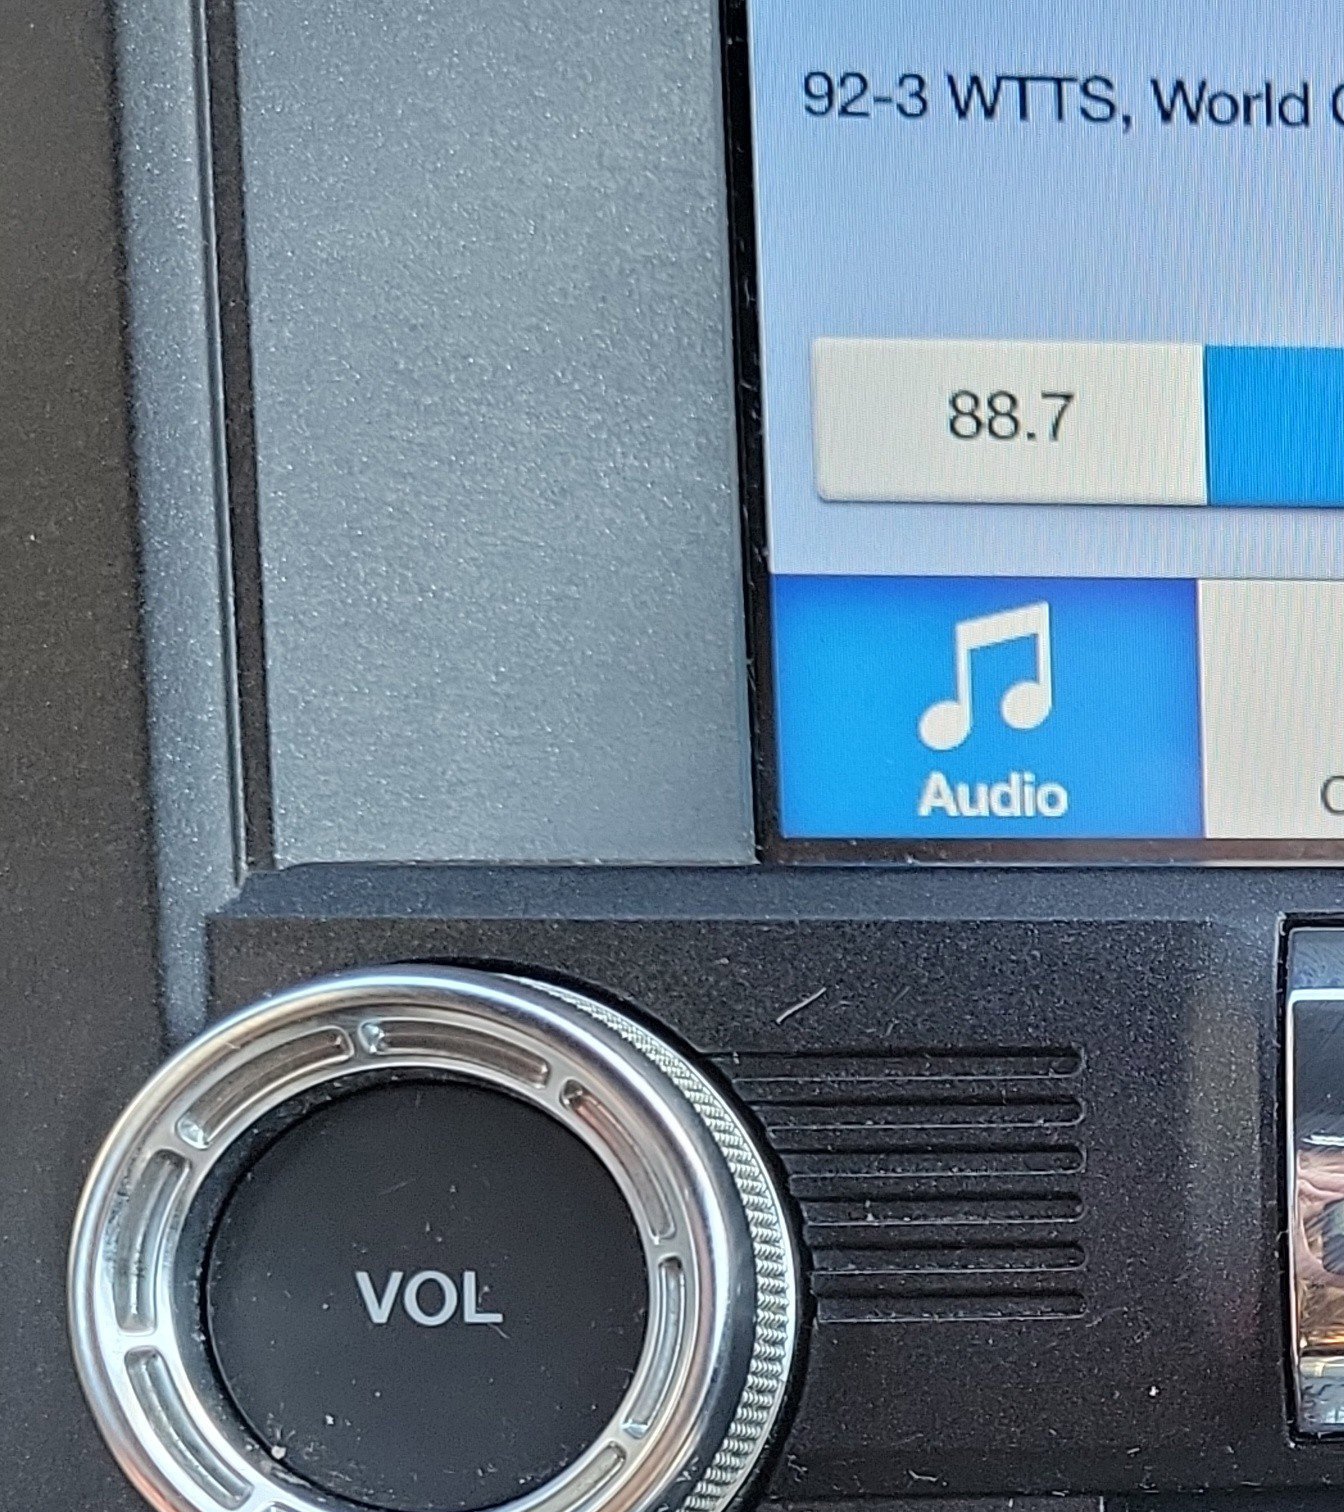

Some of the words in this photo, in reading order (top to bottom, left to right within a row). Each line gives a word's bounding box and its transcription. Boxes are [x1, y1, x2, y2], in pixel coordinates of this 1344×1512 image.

[802, 71, 928, 118] 92-3
[947, 75, 1132, 131] WTTS,
[1150, 78, 1310, 130] World
[948, 391, 1075, 441] 88.7
[918, 772, 1068, 819] Audio
[356, 1270, 504, 1326] VOL
